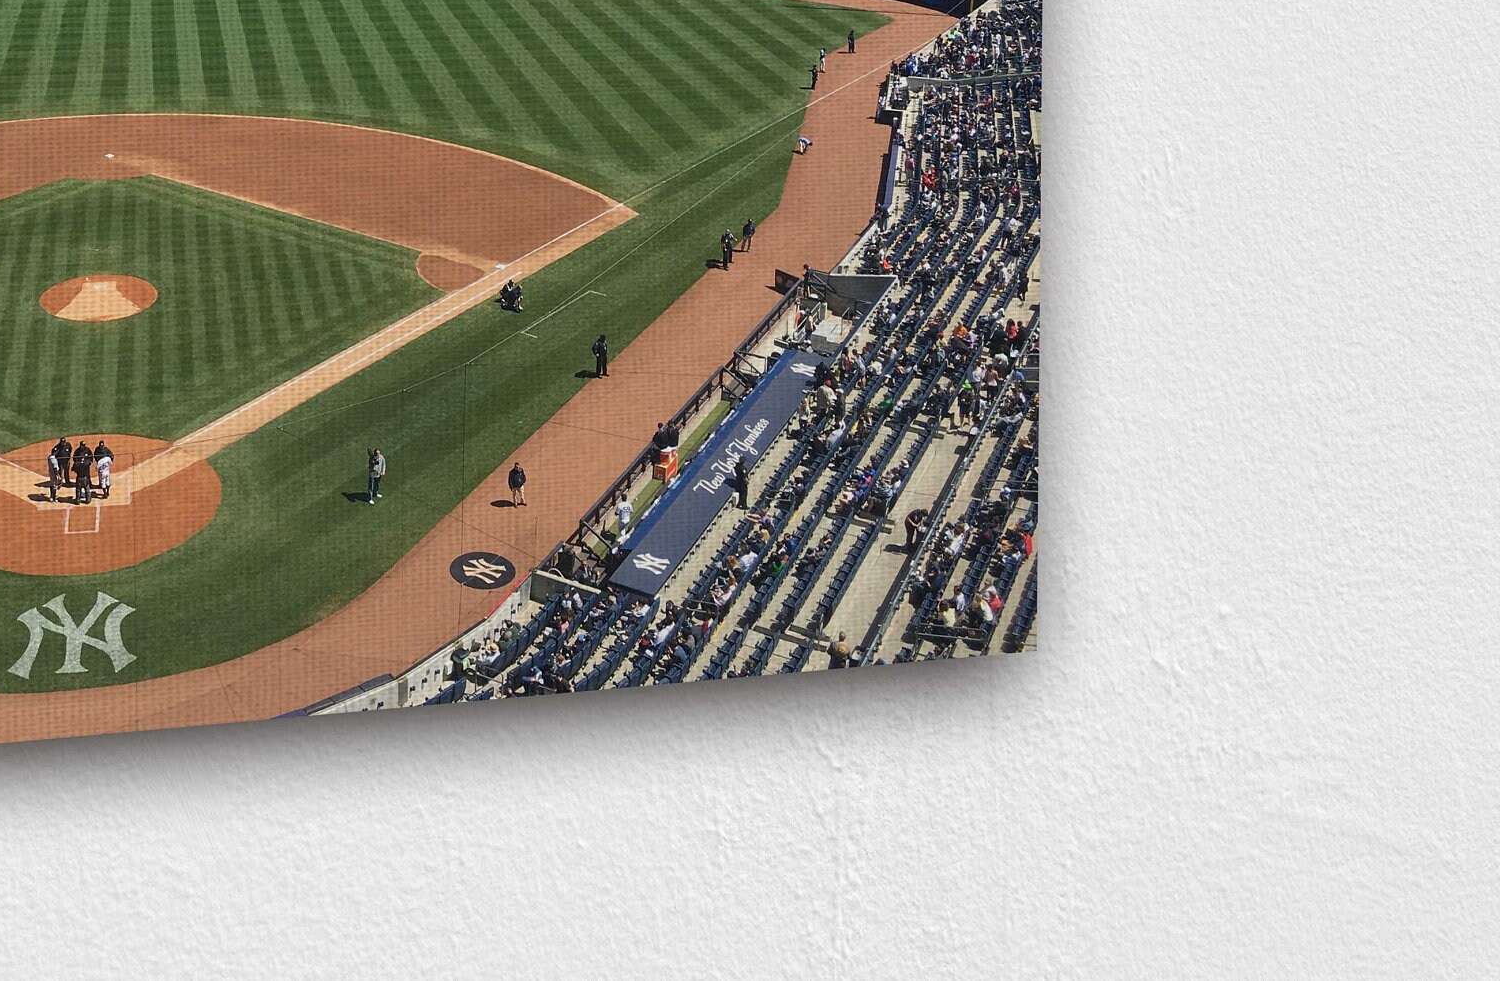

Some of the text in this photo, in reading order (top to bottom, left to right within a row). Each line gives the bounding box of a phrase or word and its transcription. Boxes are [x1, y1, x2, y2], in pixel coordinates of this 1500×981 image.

[693, 418, 770, 494] New York Yankees
